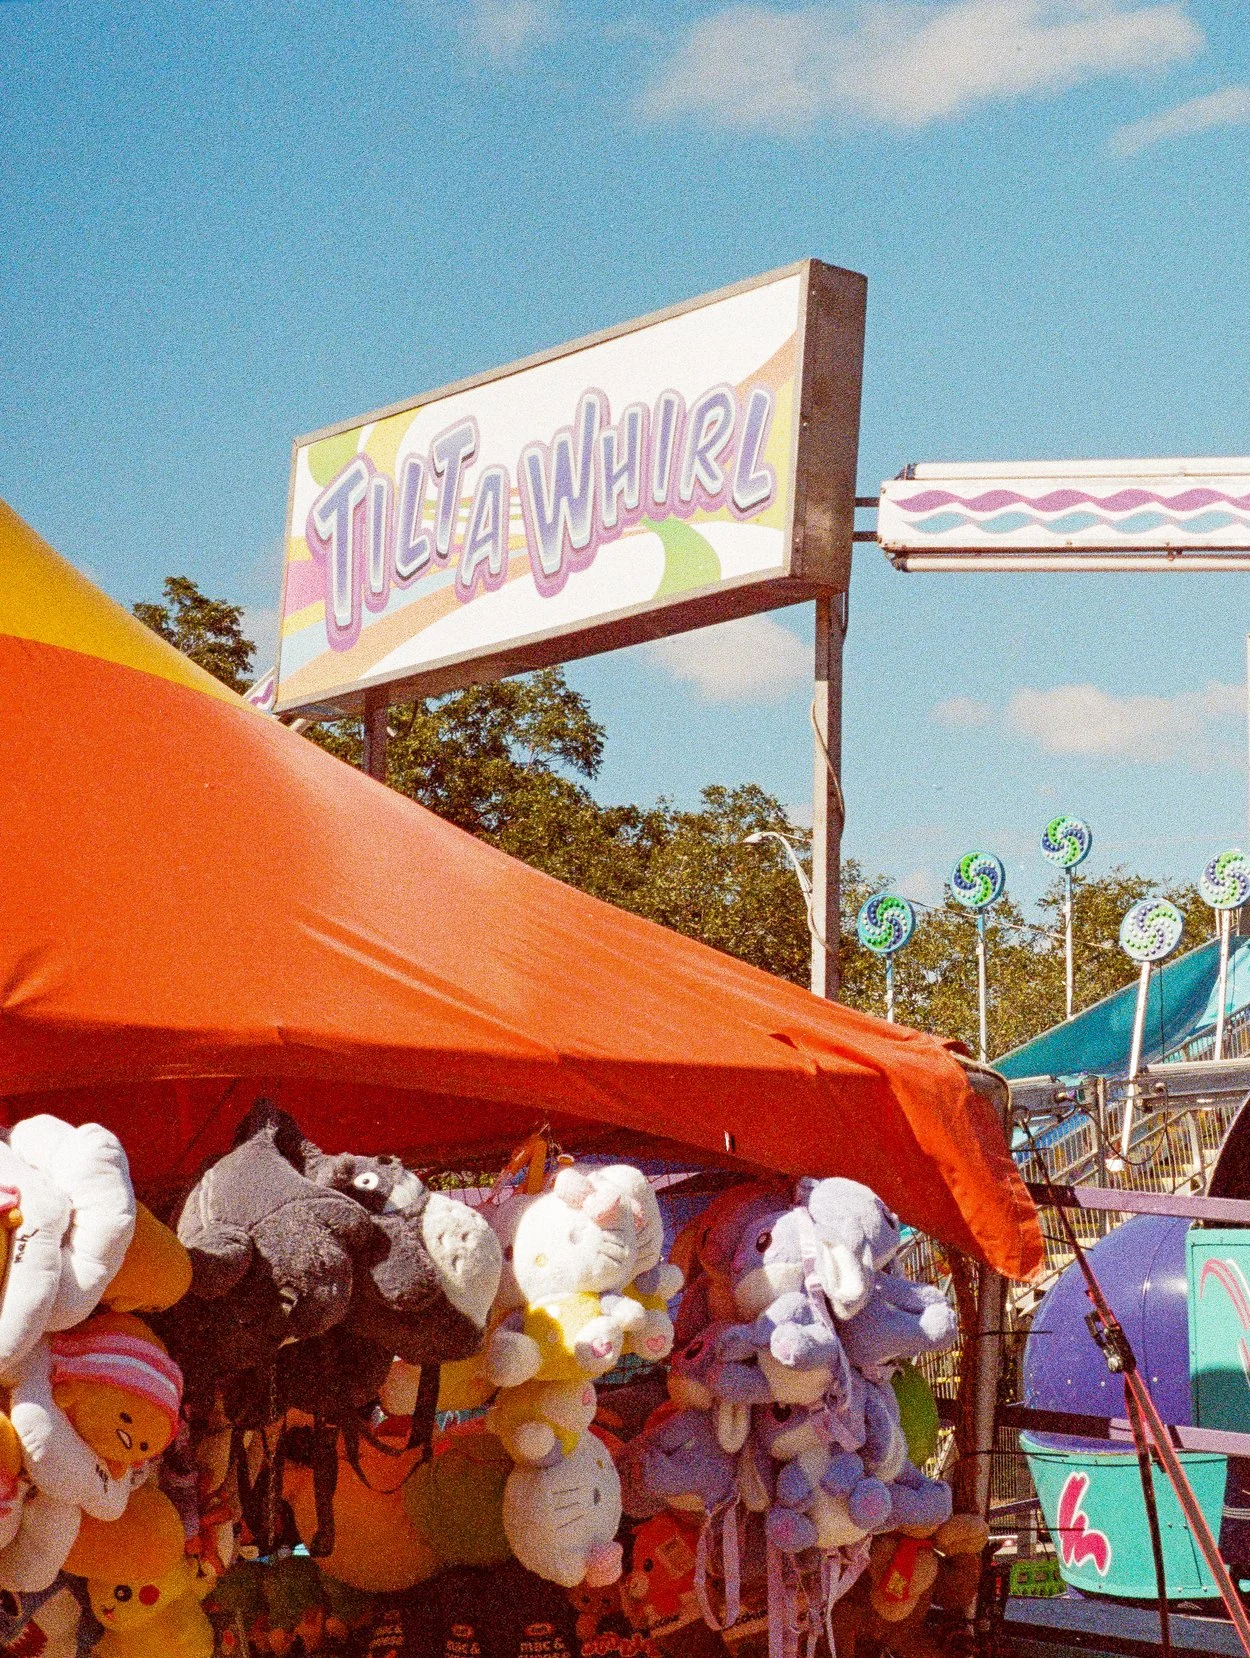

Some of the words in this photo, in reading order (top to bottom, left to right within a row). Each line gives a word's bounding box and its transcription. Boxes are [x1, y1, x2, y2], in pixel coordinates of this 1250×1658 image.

[308, 416, 479, 650] TILT
[455, 465, 511, 600] A
[519, 385, 777, 598] WHIRL
